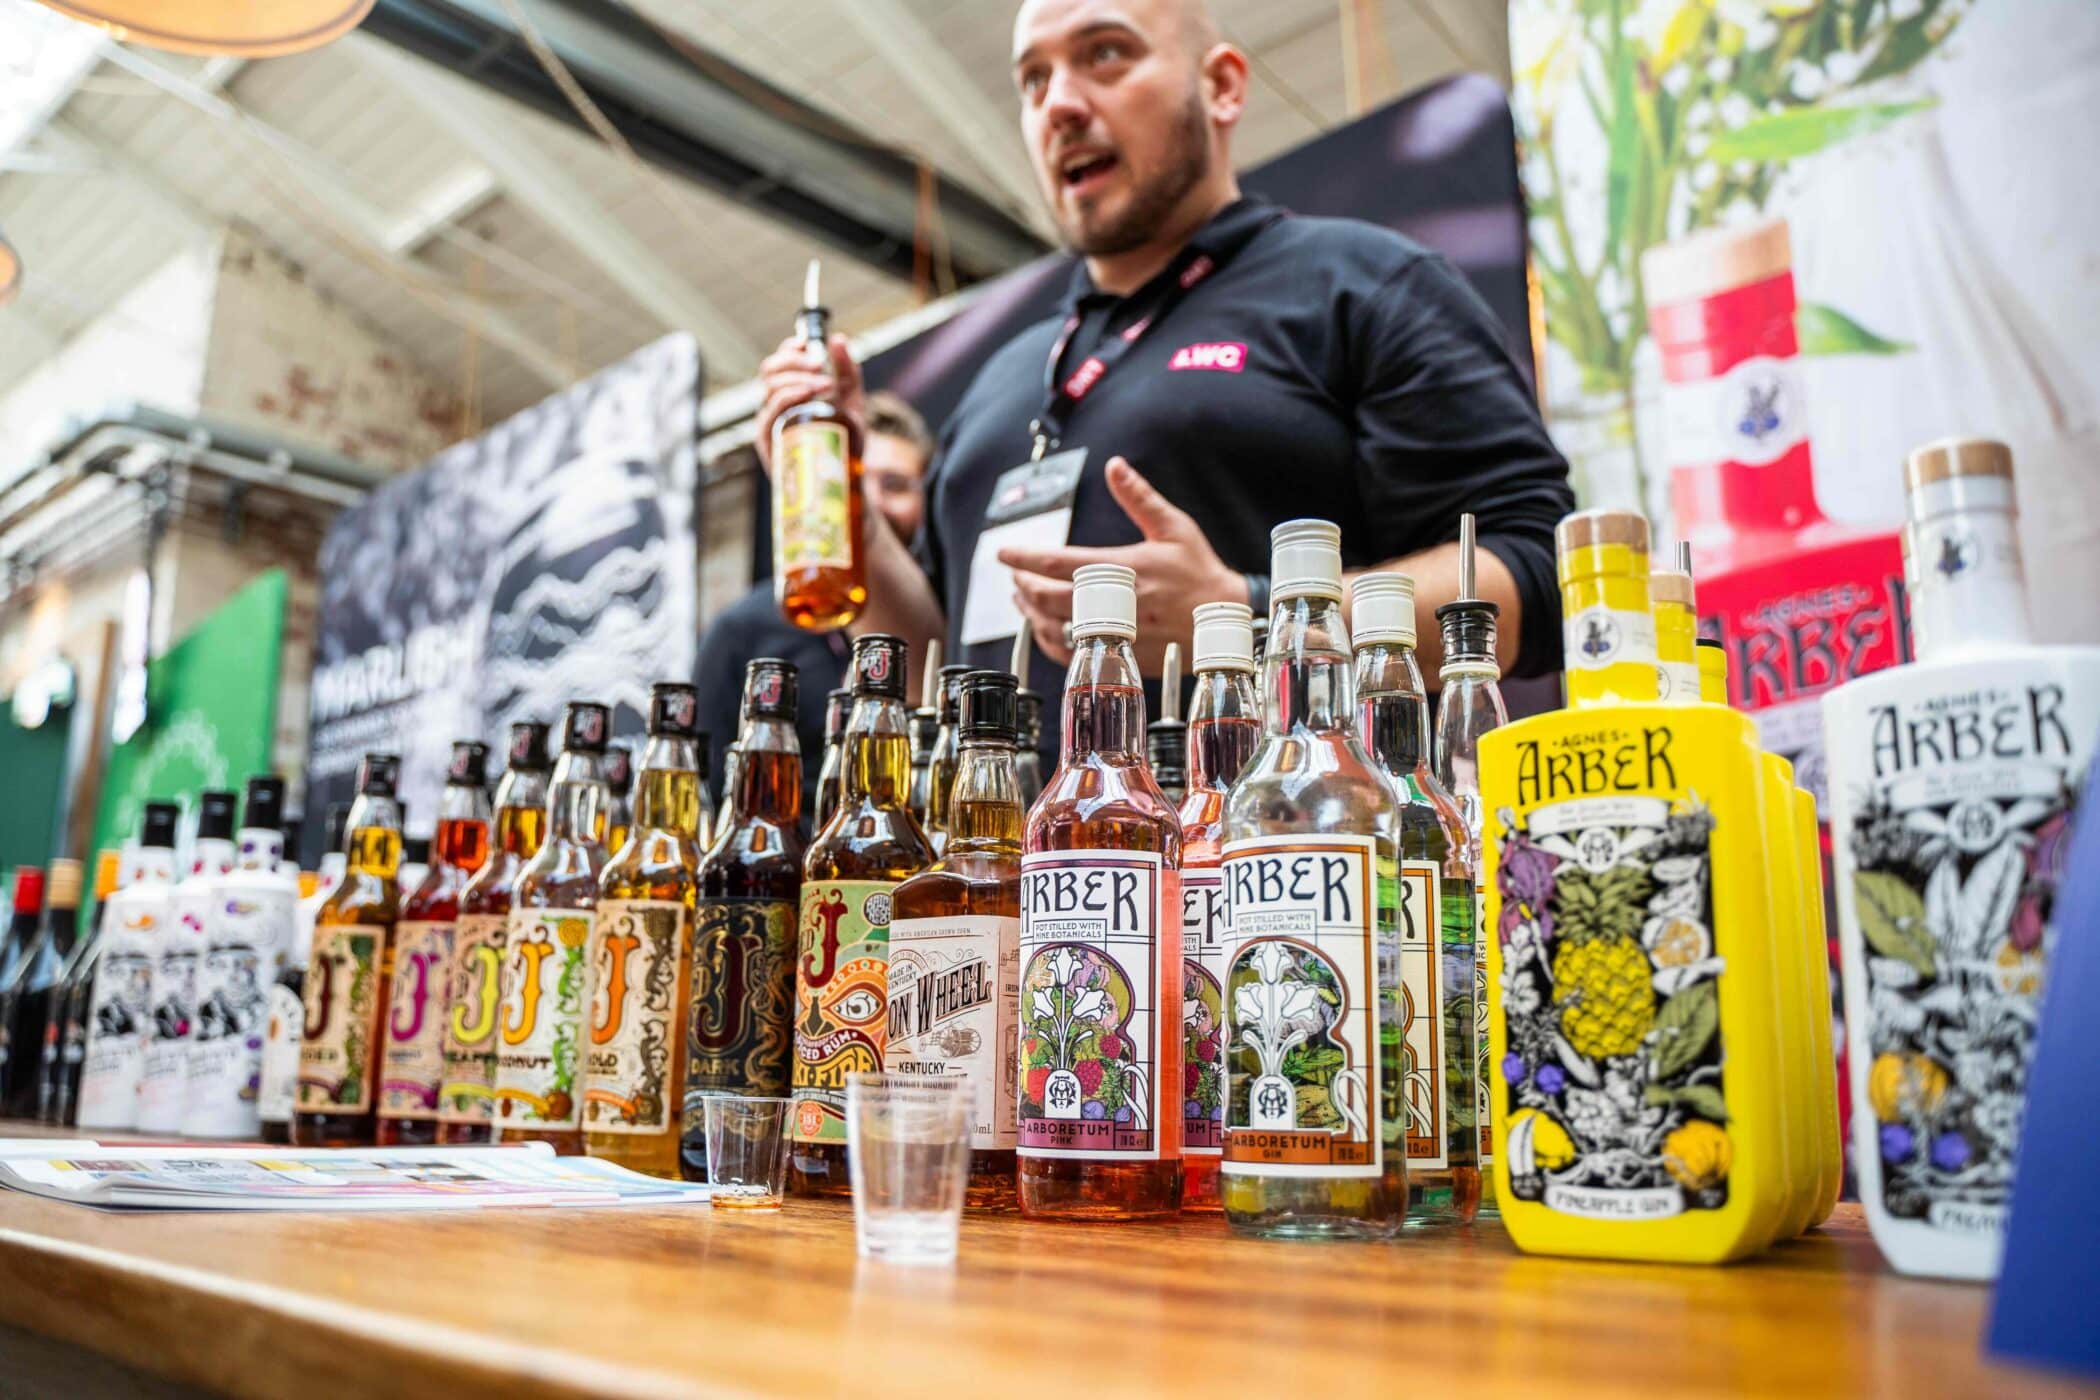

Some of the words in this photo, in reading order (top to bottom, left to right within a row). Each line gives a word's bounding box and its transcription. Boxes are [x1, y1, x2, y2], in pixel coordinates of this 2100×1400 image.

[1869, 684, 2070, 777] ARBER
[1561, 730, 1621, 748] AGNES
[1516, 726, 1677, 806] ARBER
[1223, 857, 1352, 929] ARBER
[1022, 871, 1138, 932] ARBER
[1253, 914, 1284, 924] STILLED
[1286, 912, 1311, 922] WITH
[1049, 922, 1077, 931] STILLED
[1079, 921, 1102, 930] WITH
[1255, 923, 1311, 932] BOTANICALS
[1051, 930, 1102, 939] BOTANICALS
[916, 960, 993, 1037] WHEEL
[822, 1030, 852, 1057] RUM
[588, 1052, 618, 1067] OLD
[691, 1058, 740, 1075] DARK
[898, 1061, 946, 1075] KENTUCKY
[1026, 1124, 1109, 1137] ARBORETUM
[1050, 1136, 1073, 1145] PINK
[1232, 1134, 1327, 1149] ARBORETUM
[1263, 1150, 1282, 1159] GIN
